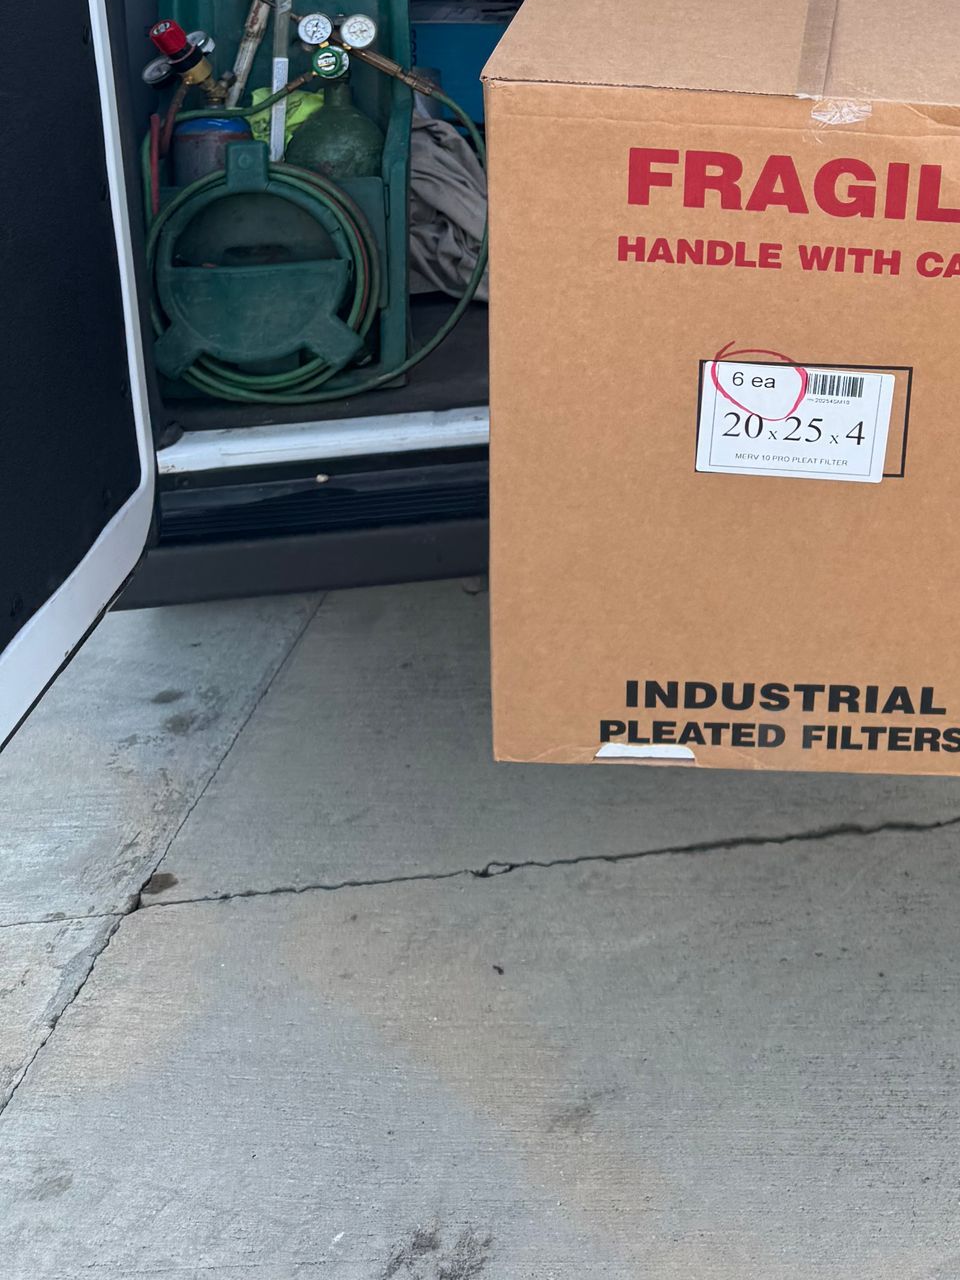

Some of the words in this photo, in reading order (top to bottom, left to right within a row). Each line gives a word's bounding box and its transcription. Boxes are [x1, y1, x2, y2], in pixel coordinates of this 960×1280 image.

[617, 236, 783, 269] HANDLE
[799, 244, 900, 276] WITH
[732, 371, 744, 387] 6
[751, 375, 776, 389] ea
[722, 412, 764, 439] 20
[768, 430, 778, 440] x
[783, 416, 823, 443] 25
[829, 434, 839, 444] x
[845, 421, 865, 445] 4
[792, 456, 818, 464] PLEAT
[819, 458, 848, 466] FILTER
[625, 680, 946, 715] INDUSTRIAL
[600, 719, 786, 748] PLEATED
